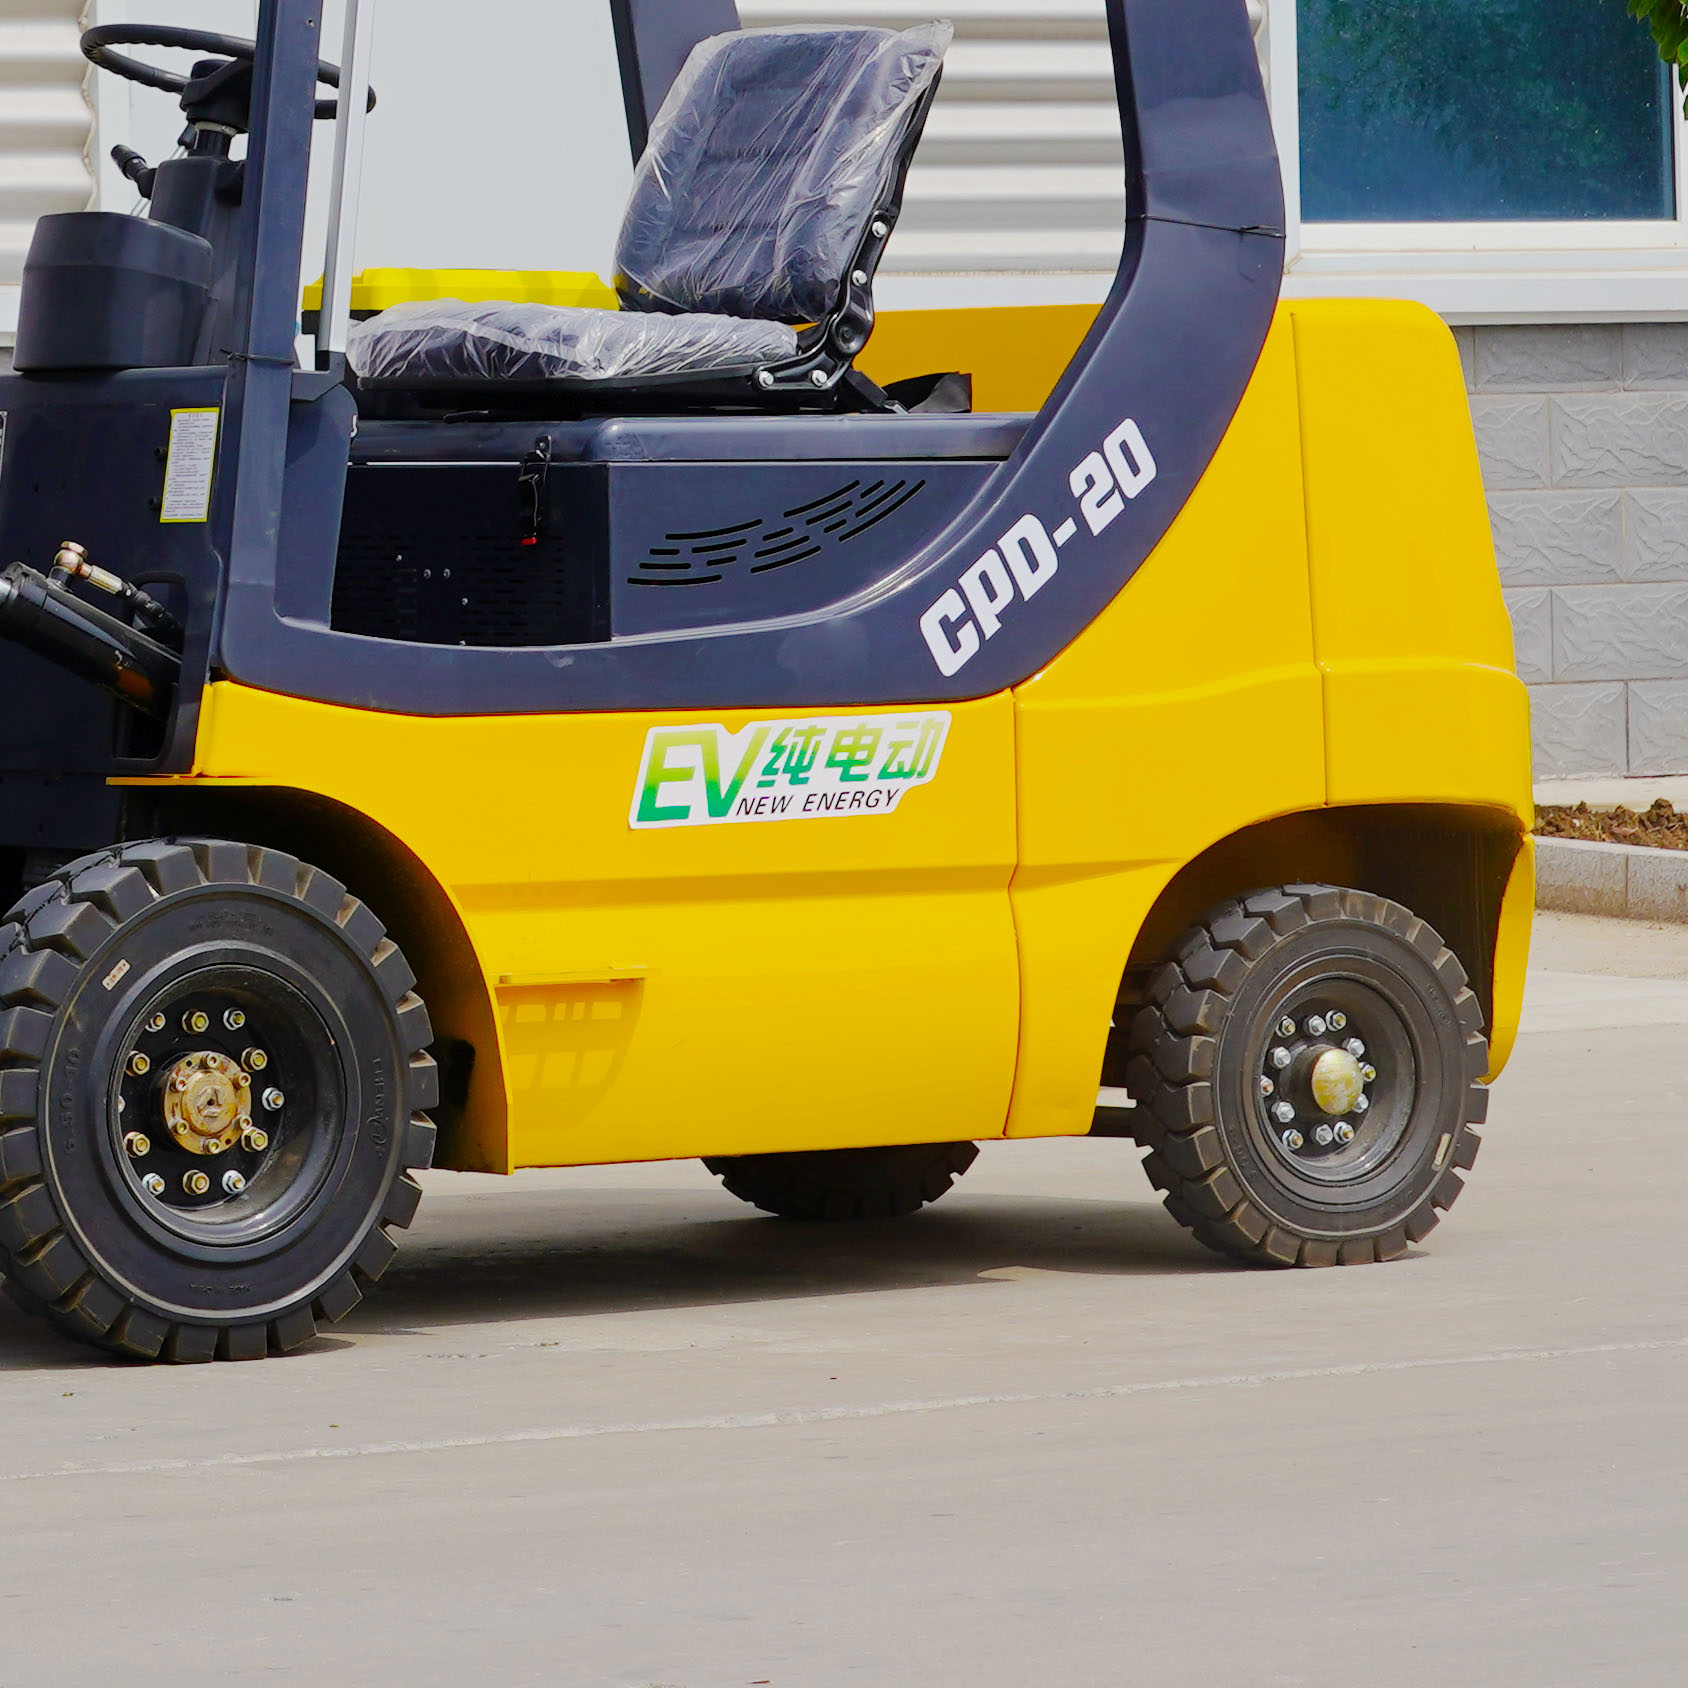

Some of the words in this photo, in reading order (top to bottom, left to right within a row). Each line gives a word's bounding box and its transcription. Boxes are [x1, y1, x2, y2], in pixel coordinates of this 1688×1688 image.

[919, 417, 1158, 677] CPD-20
[637, 726, 771, 822] EV
[757, 718, 944, 786] 纯电动
[736, 794, 794, 817] NEW
[802, 787, 900, 813] ENERGY
